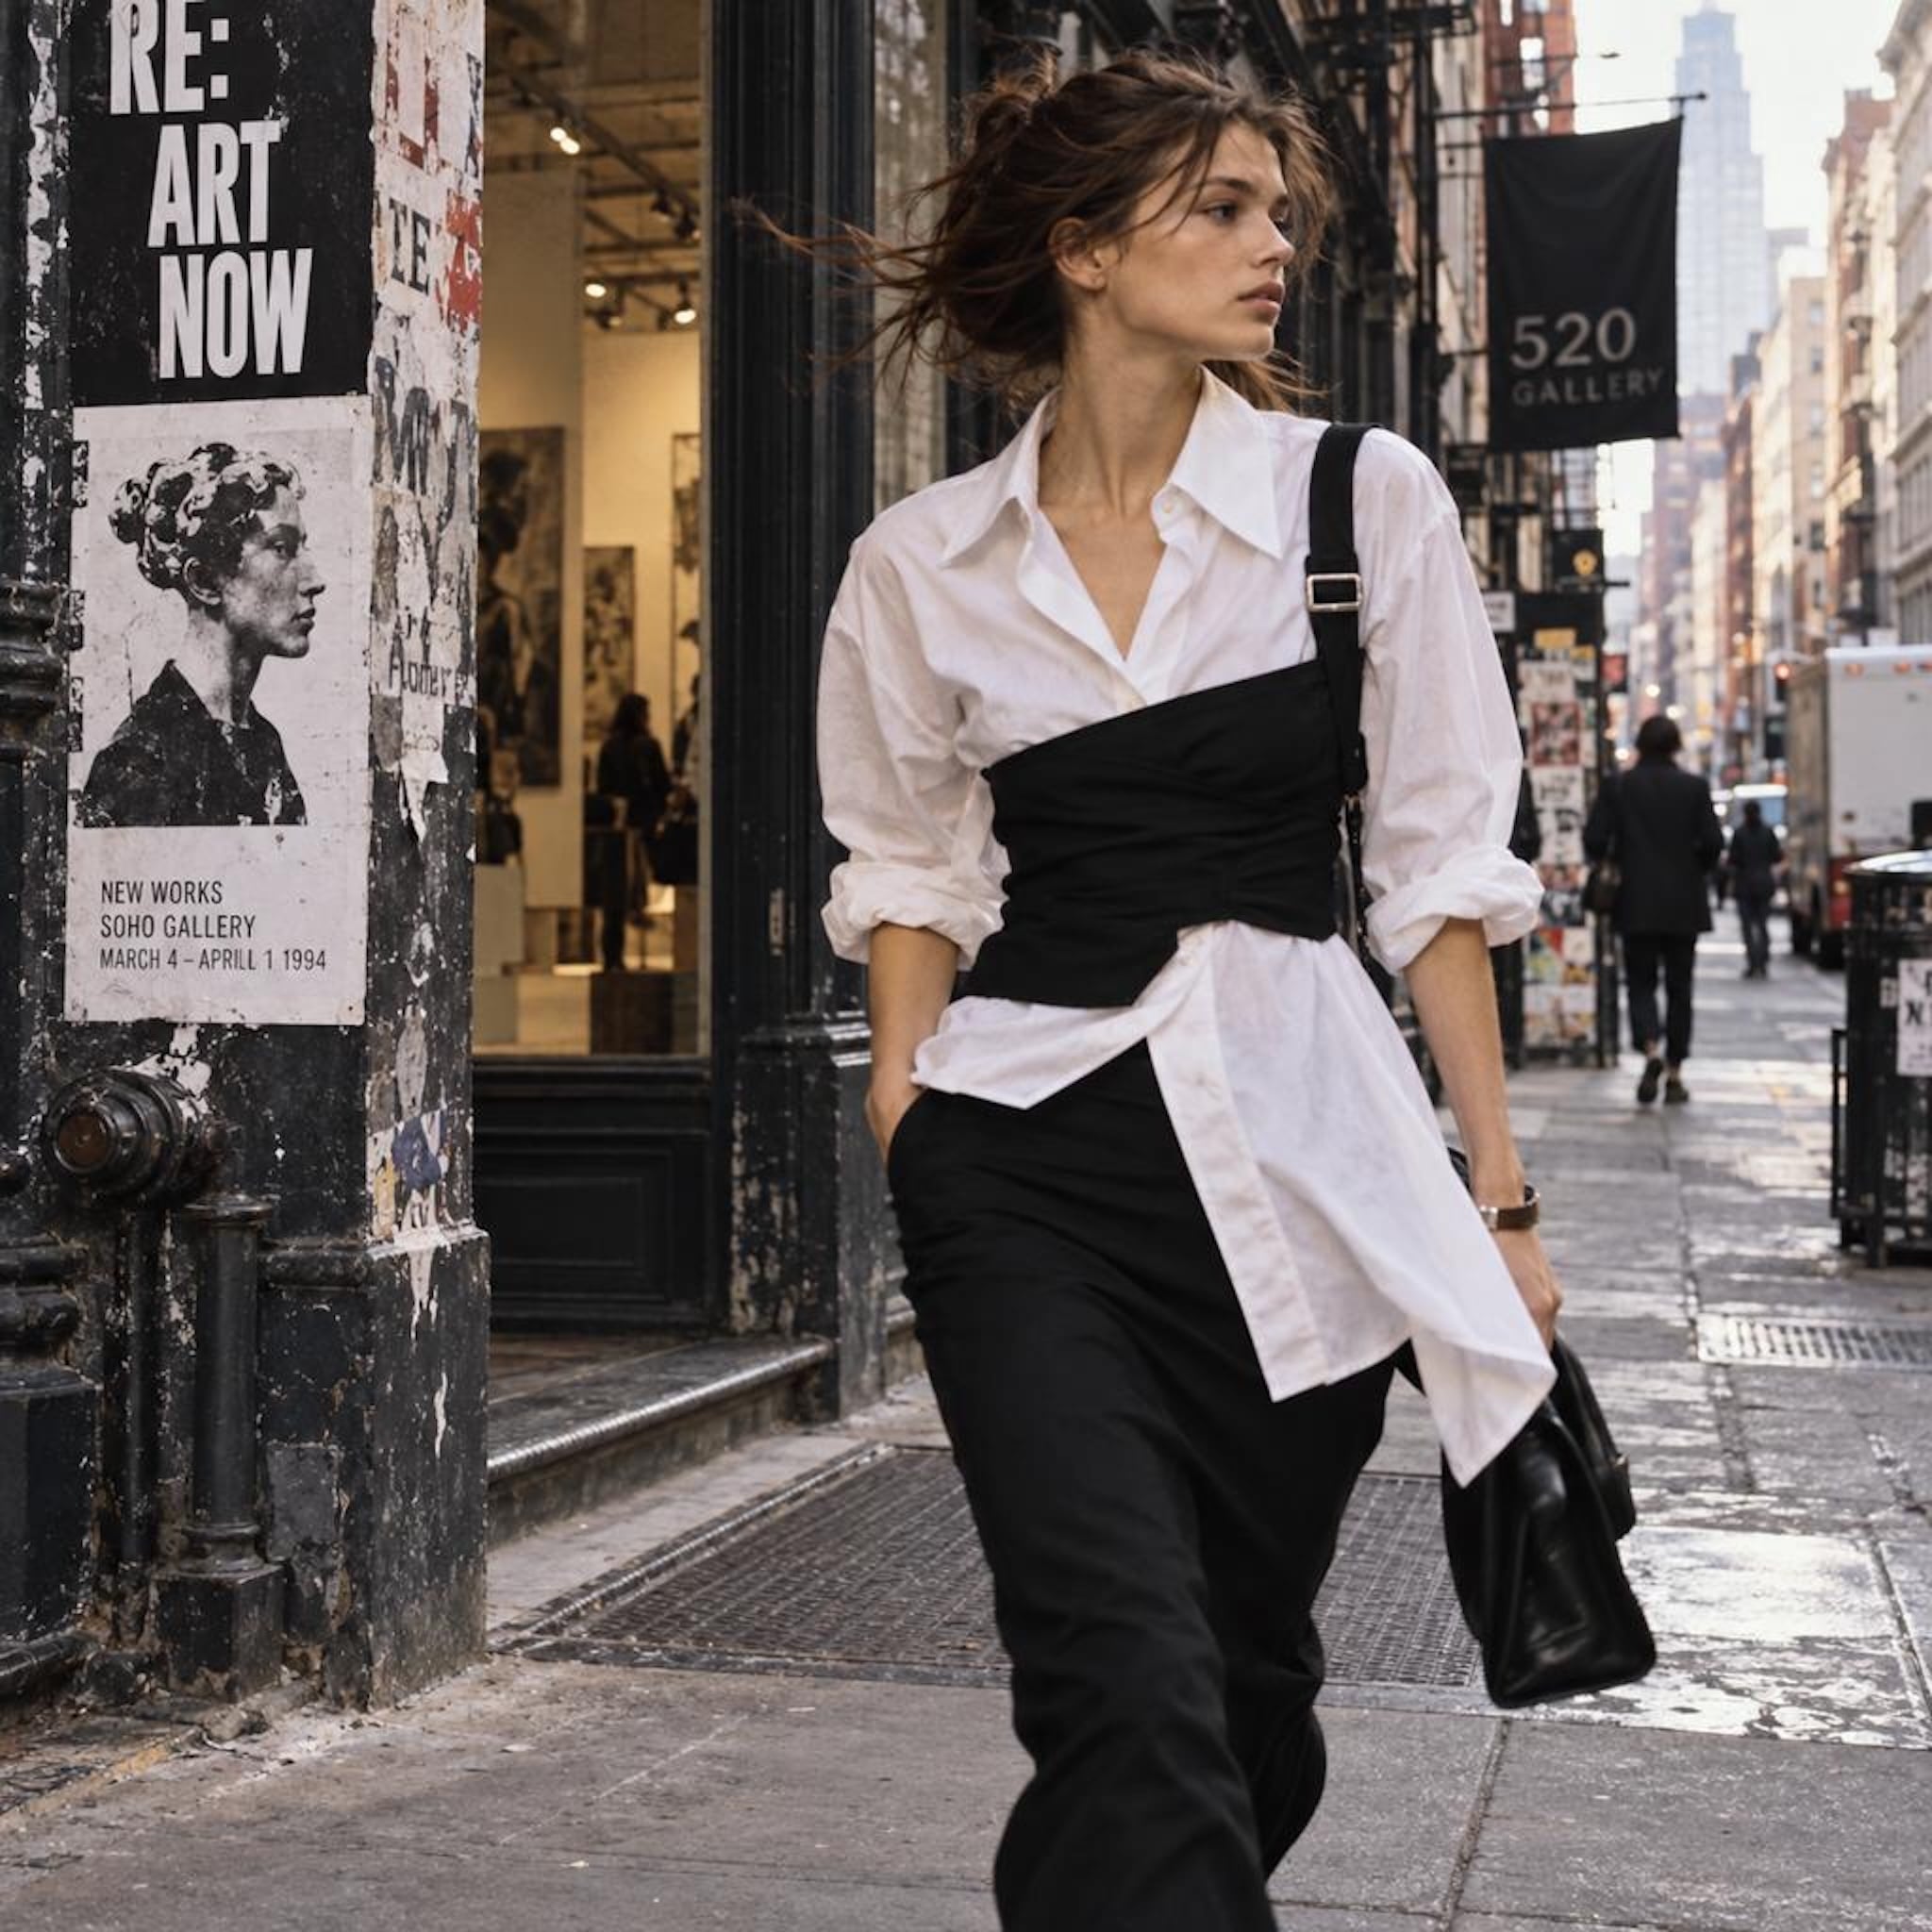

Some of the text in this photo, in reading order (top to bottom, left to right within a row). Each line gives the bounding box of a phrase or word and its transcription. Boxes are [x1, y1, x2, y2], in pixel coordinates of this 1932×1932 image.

[108, 0, 230, 115] RE:
[147, 120, 281, 247] ART
[158, 248, 313, 379] NOW
[1510, 307, 1636, 369] 520
[1513, 366, 1663, 407] GALLERY
[101, 880, 224, 904] NEW WORKS
[100, 914, 257, 939] SOHO GALLERY
[99, 948, 160, 971] MARCH
[167, 948, 178, 970] 4
[198, 948, 257, 971] APRILL
[265, 949, 273, 970] 1
[283, 949, 326, 971] 1994
